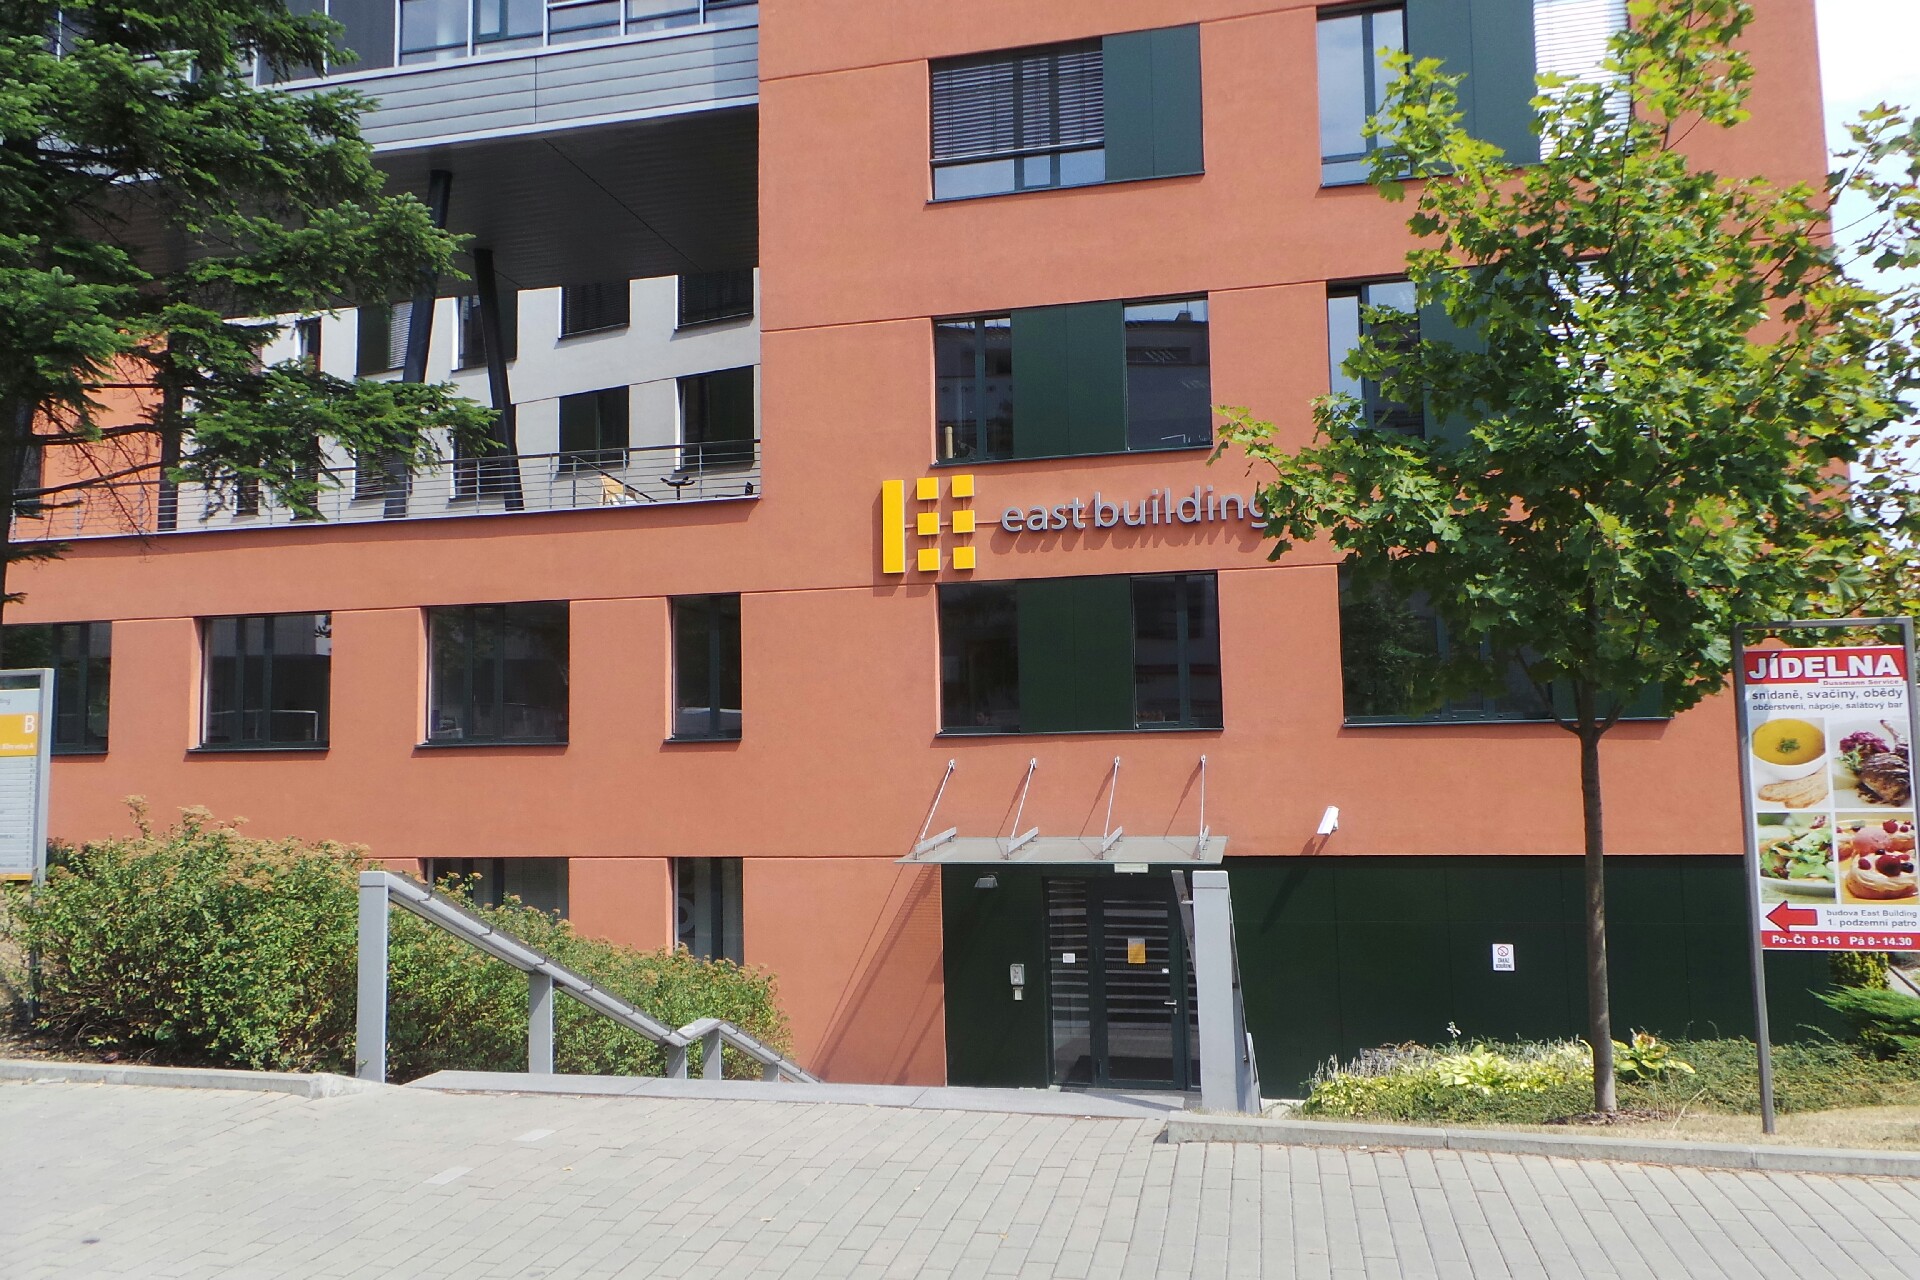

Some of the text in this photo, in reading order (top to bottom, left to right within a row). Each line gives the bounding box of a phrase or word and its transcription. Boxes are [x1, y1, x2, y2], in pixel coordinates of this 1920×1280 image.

[1001, 497, 1086, 532] east
[1748, 653, 1900, 679] JÍDELNA
[1863, 688, 1903, 699] obědy
[24, 714, 35, 734] B
[1883, 910, 1917, 919] Building
[1892, 920, 1917, 928] patro
[1772, 934, 1806, 945] Po-Čt
[1849, 937, 1865, 946] Pá
